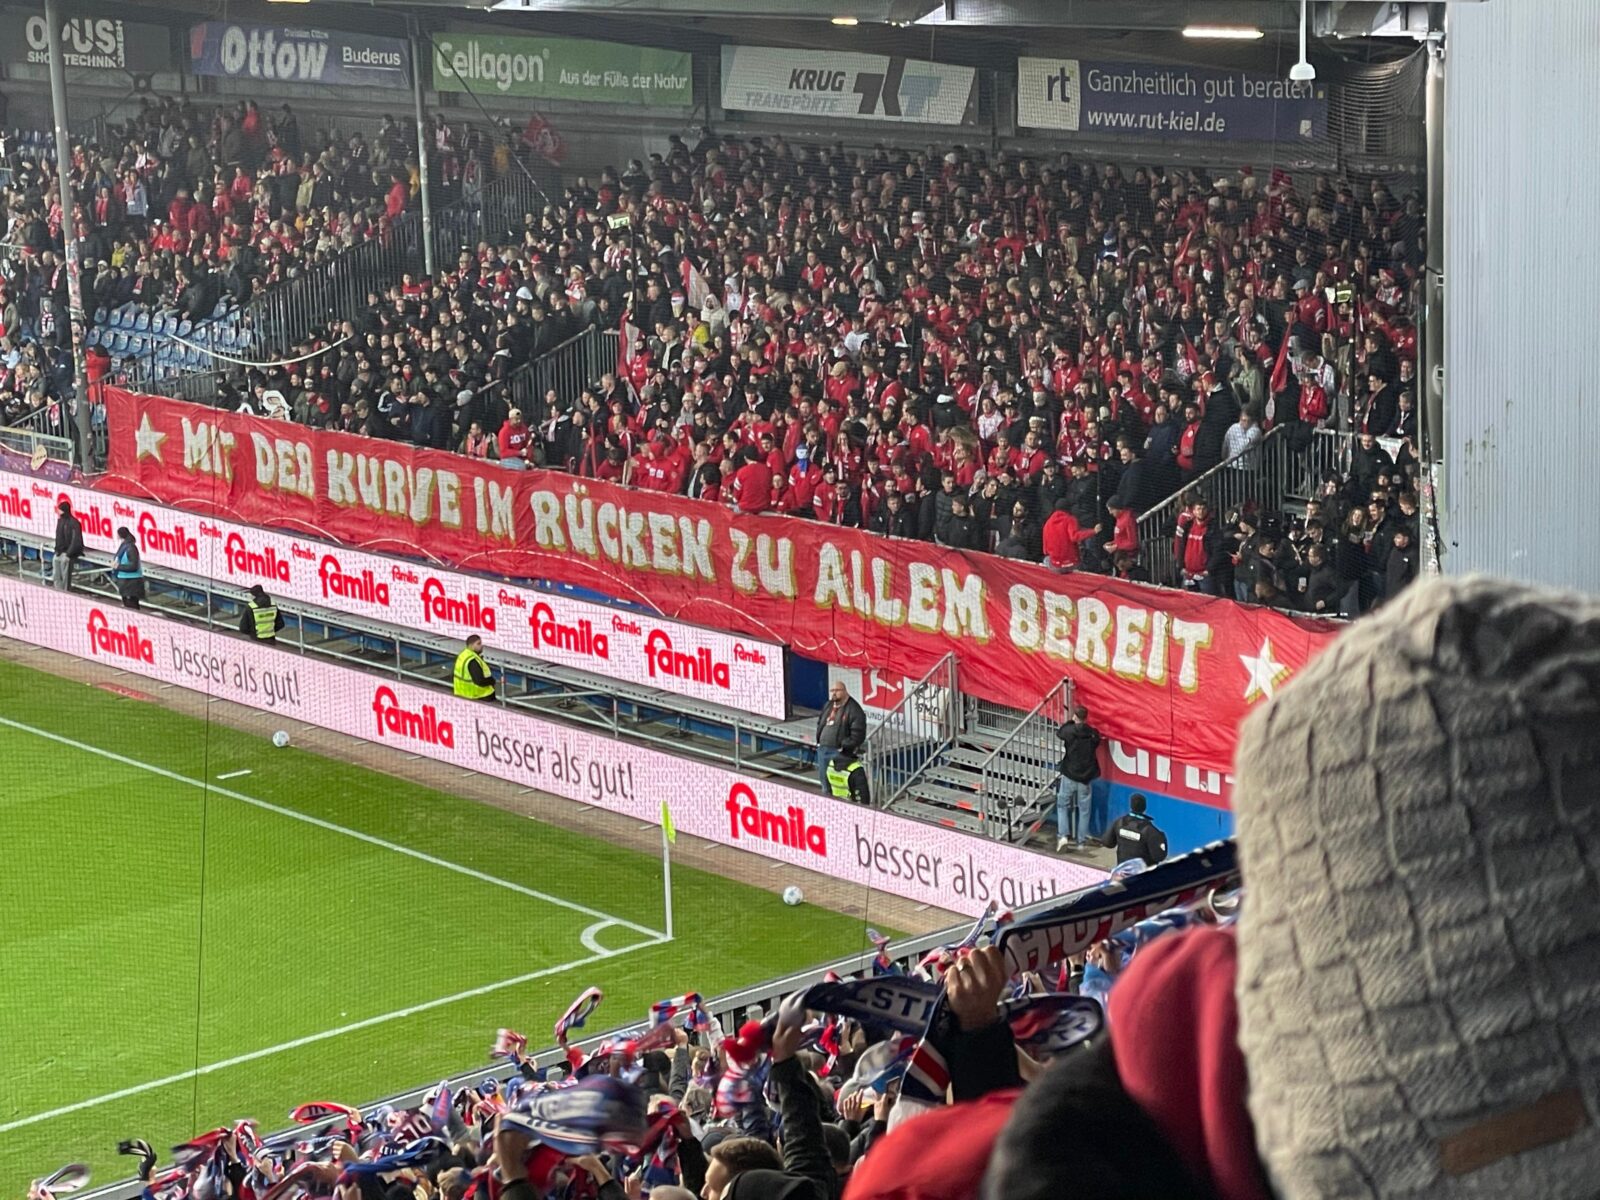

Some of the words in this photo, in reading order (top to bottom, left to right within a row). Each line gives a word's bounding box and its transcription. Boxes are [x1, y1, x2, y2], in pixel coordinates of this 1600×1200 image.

[27, 51, 117, 68] SHOTECHNIK
[221, 26, 328, 79] Ottow
[342, 46, 401, 66] Buderus
[559, 68, 580, 85] Aus
[582, 70, 600, 87] der
[632, 72, 653, 89] der
[654, 73, 688, 89] Natur
[788, 68, 846, 91] KRUG
[1047, 66, 1071, 103] rt
[1087, 69, 1196, 97] Ganzheitlich
[1204, 77, 1235, 103] gut
[1087, 109, 1226, 133] www.rut-kiel.de
[181, 416, 235, 482] MIT
[250, 431, 314, 500] DER
[326, 449, 462, 528] KURVE
[474, 476, 517, 544] IM
[530, 481, 717, 582] RÜCKEN
[729, 527, 797, 600] ZU
[814, 542, 993, 644] ALLEM
[1008, 584, 1213, 692] BEREIT
[55, 492, 113, 539] mila
[137, 512, 199, 560] famila
[224, 532, 290, 583] famila
[318, 554, 390, 607] famila
[392, 565, 419, 584] famila
[420, 577, 496, 632] famila
[497, 588, 527, 609] famila
[529, 602, 609, 660] famila
[611, 614, 642, 637] famila
[644, 629, 731, 690] famila
[733, 643, 766, 666] famila
[86, 608, 154, 665] famila
[170, 635, 227, 684] besser
[233, 654, 258, 693] als
[263, 670, 301, 707] gut!
[372, 685, 454, 750] famila
[474, 718, 544, 774] besser
[551, 743, 581, 785] als
[588, 762, 635, 801] gut!
[725, 782, 827, 857] famila
[854, 824, 942, 888] besser
[952, 854, 990, 902] als
